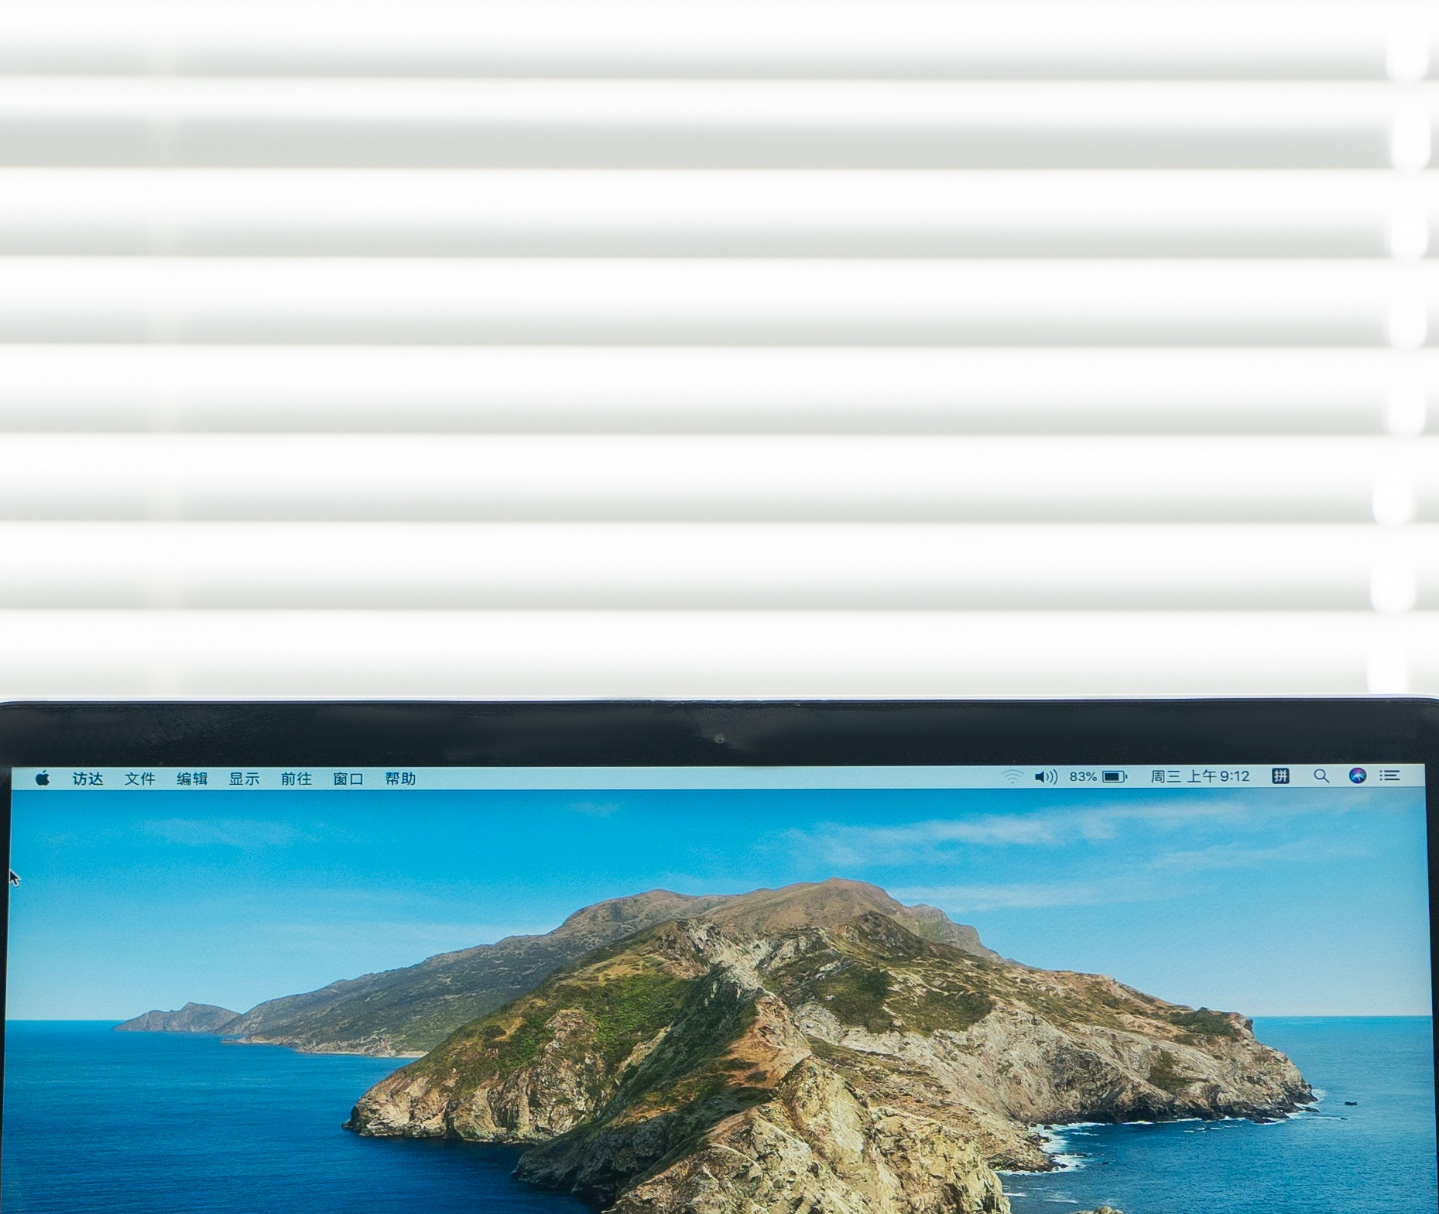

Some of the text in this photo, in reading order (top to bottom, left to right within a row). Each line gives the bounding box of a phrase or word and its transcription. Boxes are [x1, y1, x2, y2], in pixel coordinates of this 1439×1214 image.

[72, 771, 416, 787] 访达 文件 编辑 显示 前往 窗口 帮助
[1070, 770, 1097, 783] 83%
